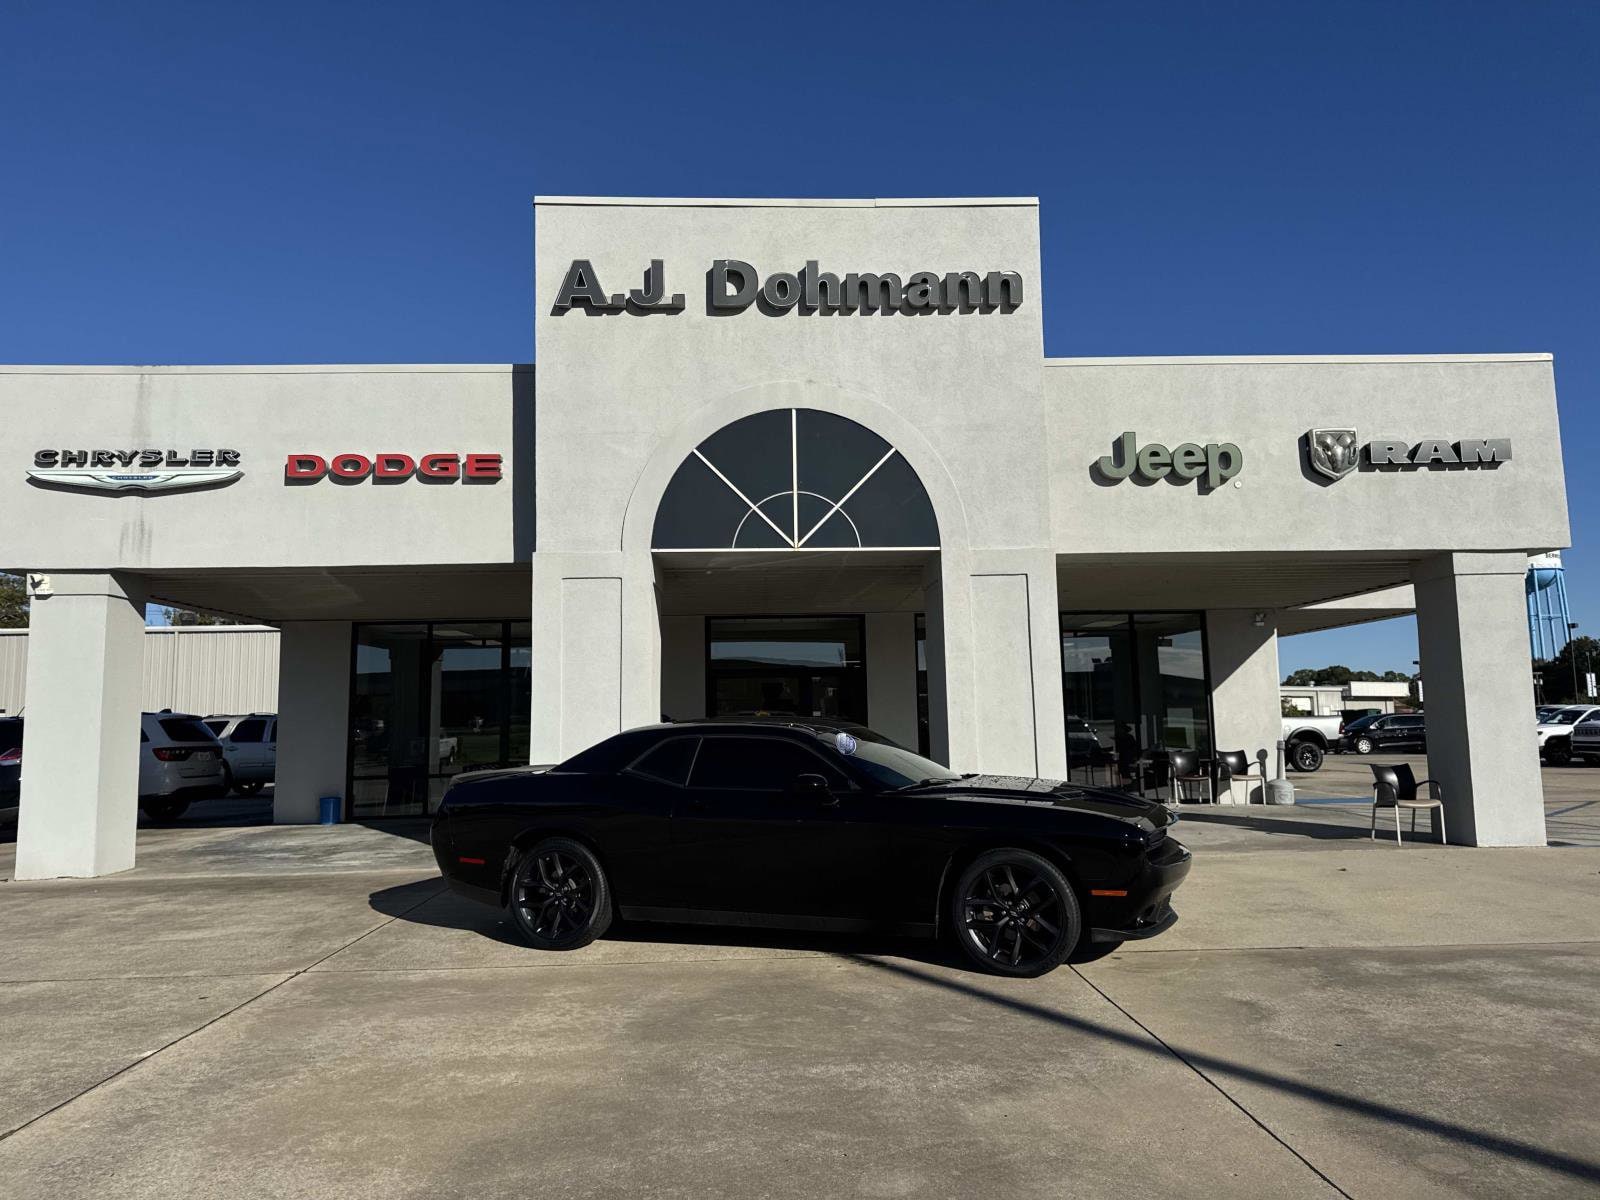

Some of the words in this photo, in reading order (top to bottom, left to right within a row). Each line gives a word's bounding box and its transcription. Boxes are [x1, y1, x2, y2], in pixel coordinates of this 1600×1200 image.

[554, 259, 685, 308] A.J.
[712, 259, 1023, 308] Dohmann
[34, 449, 240, 466] CHRYSLER
[1099, 431, 1243, 488] Jeep
[1370, 438, 1512, 465] RAM
[287, 453, 502, 479] DODGE
